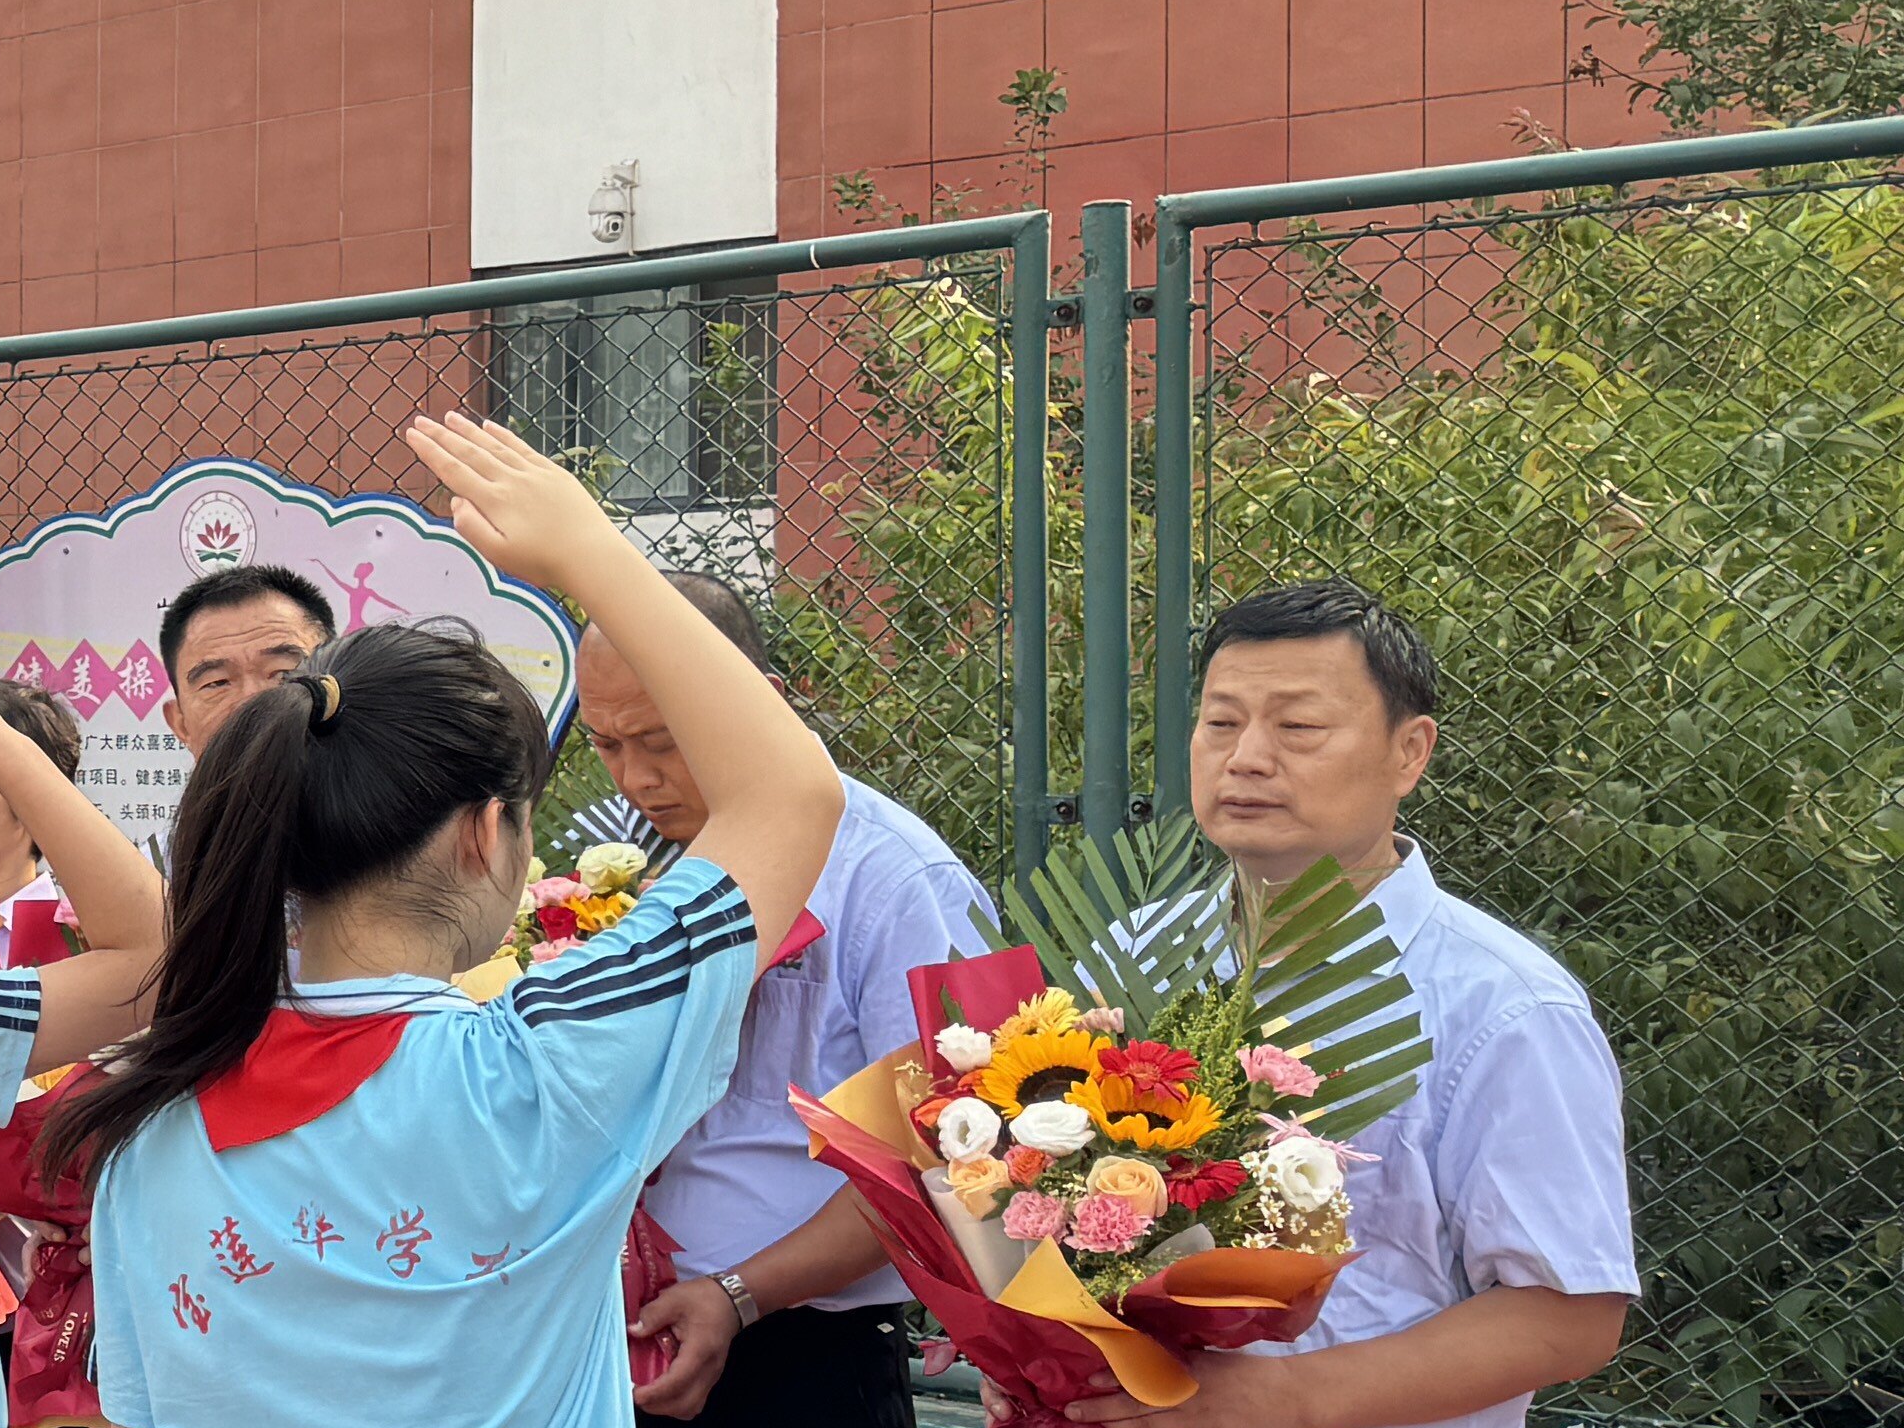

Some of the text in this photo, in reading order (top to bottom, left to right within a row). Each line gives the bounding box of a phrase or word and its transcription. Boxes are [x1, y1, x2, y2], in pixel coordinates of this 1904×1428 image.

[79, 733, 187, 751] 广大群众喜爱
